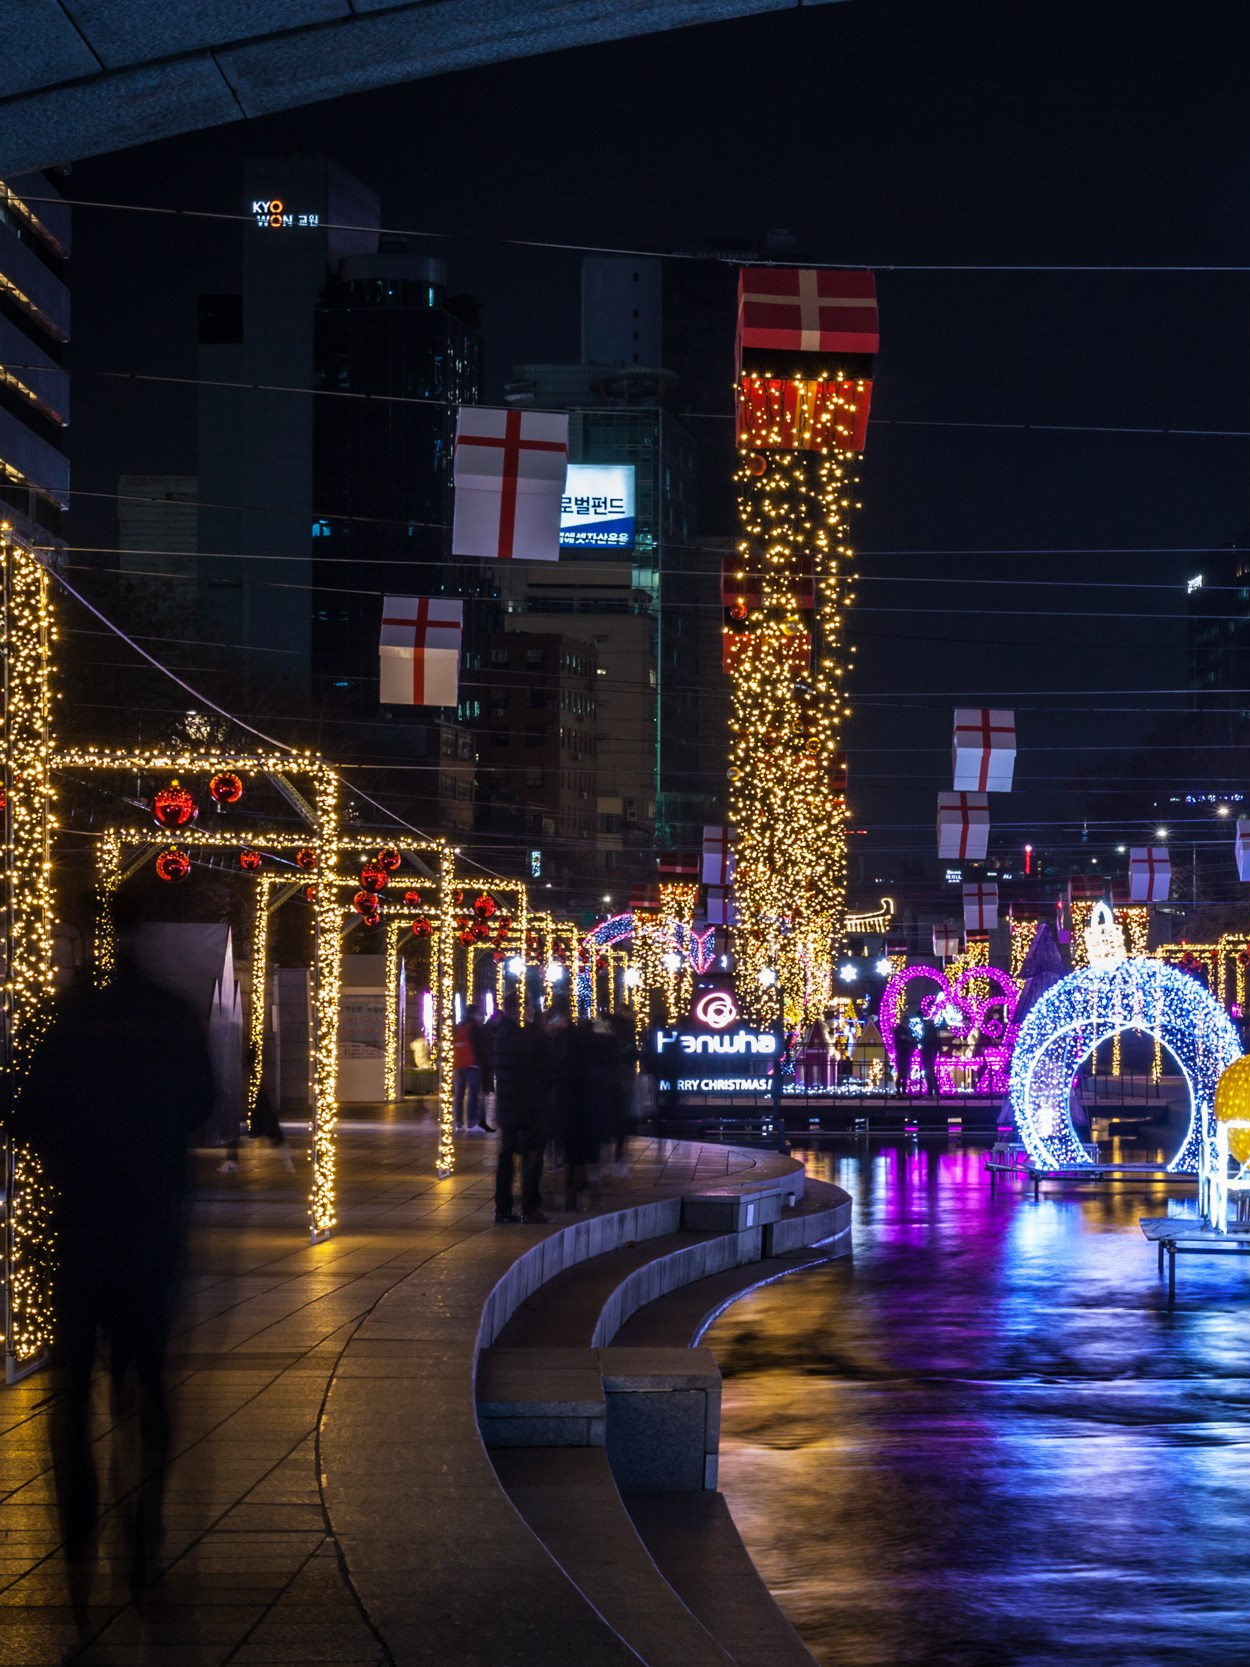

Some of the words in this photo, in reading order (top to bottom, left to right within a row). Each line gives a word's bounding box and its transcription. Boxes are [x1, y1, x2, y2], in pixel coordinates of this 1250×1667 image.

[253, 200, 283, 213] KYO
[256, 215, 293, 227] WON
[298, 215, 319, 226] 교원
[657, 1030, 776, 1053] Hanwha
[659, 1078, 700, 1091] MRRY
[701, 1078, 773, 1091] CHRISTMAS!
